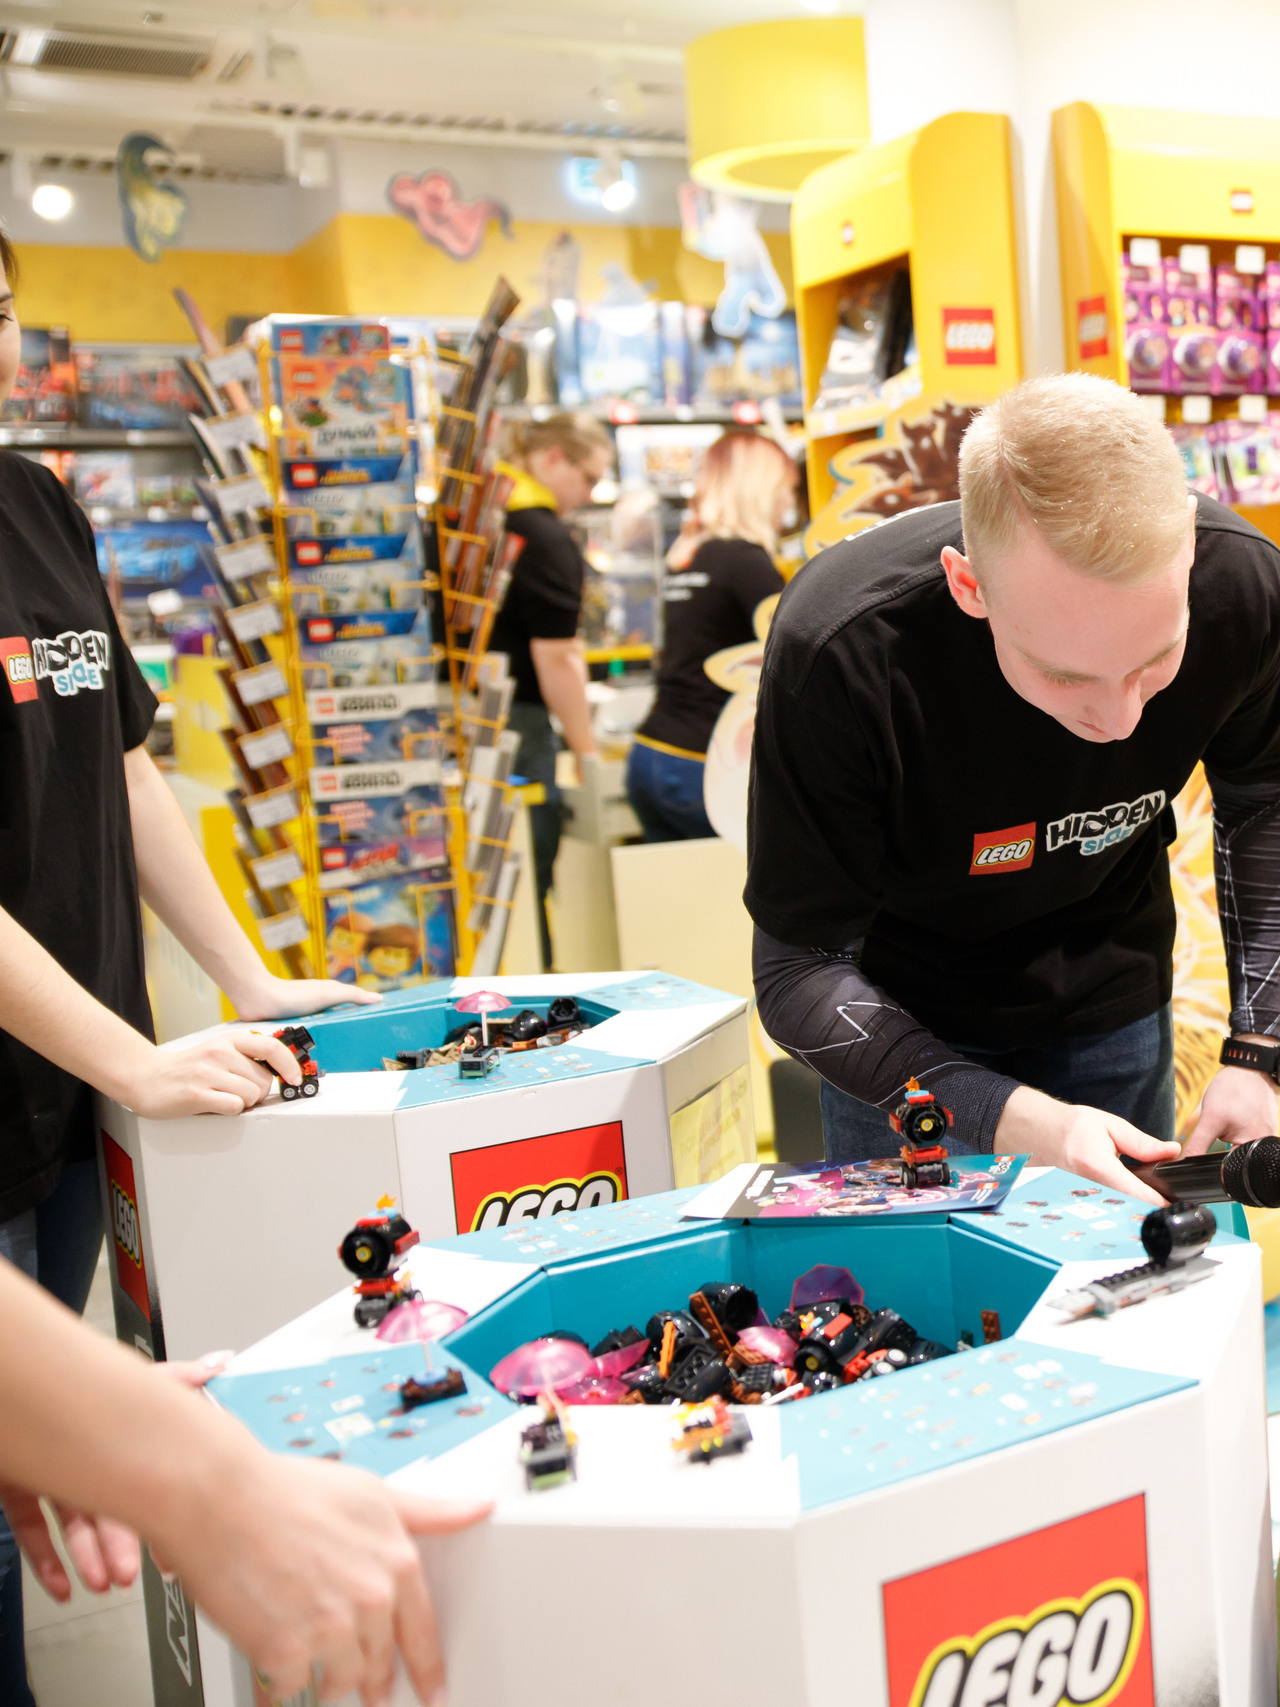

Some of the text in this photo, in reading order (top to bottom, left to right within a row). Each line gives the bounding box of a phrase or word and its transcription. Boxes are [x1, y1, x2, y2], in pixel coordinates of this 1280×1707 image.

[944, 322, 995, 351] LEGO
[7, 631, 109, 684] LEGO HIDDEN
[54, 662, 103, 694] SIDE
[974, 791, 1166, 867] LEGO HIDDEN
[1082, 827, 1132, 855] SIDE
[112, 1182, 141, 1266] LEGO
